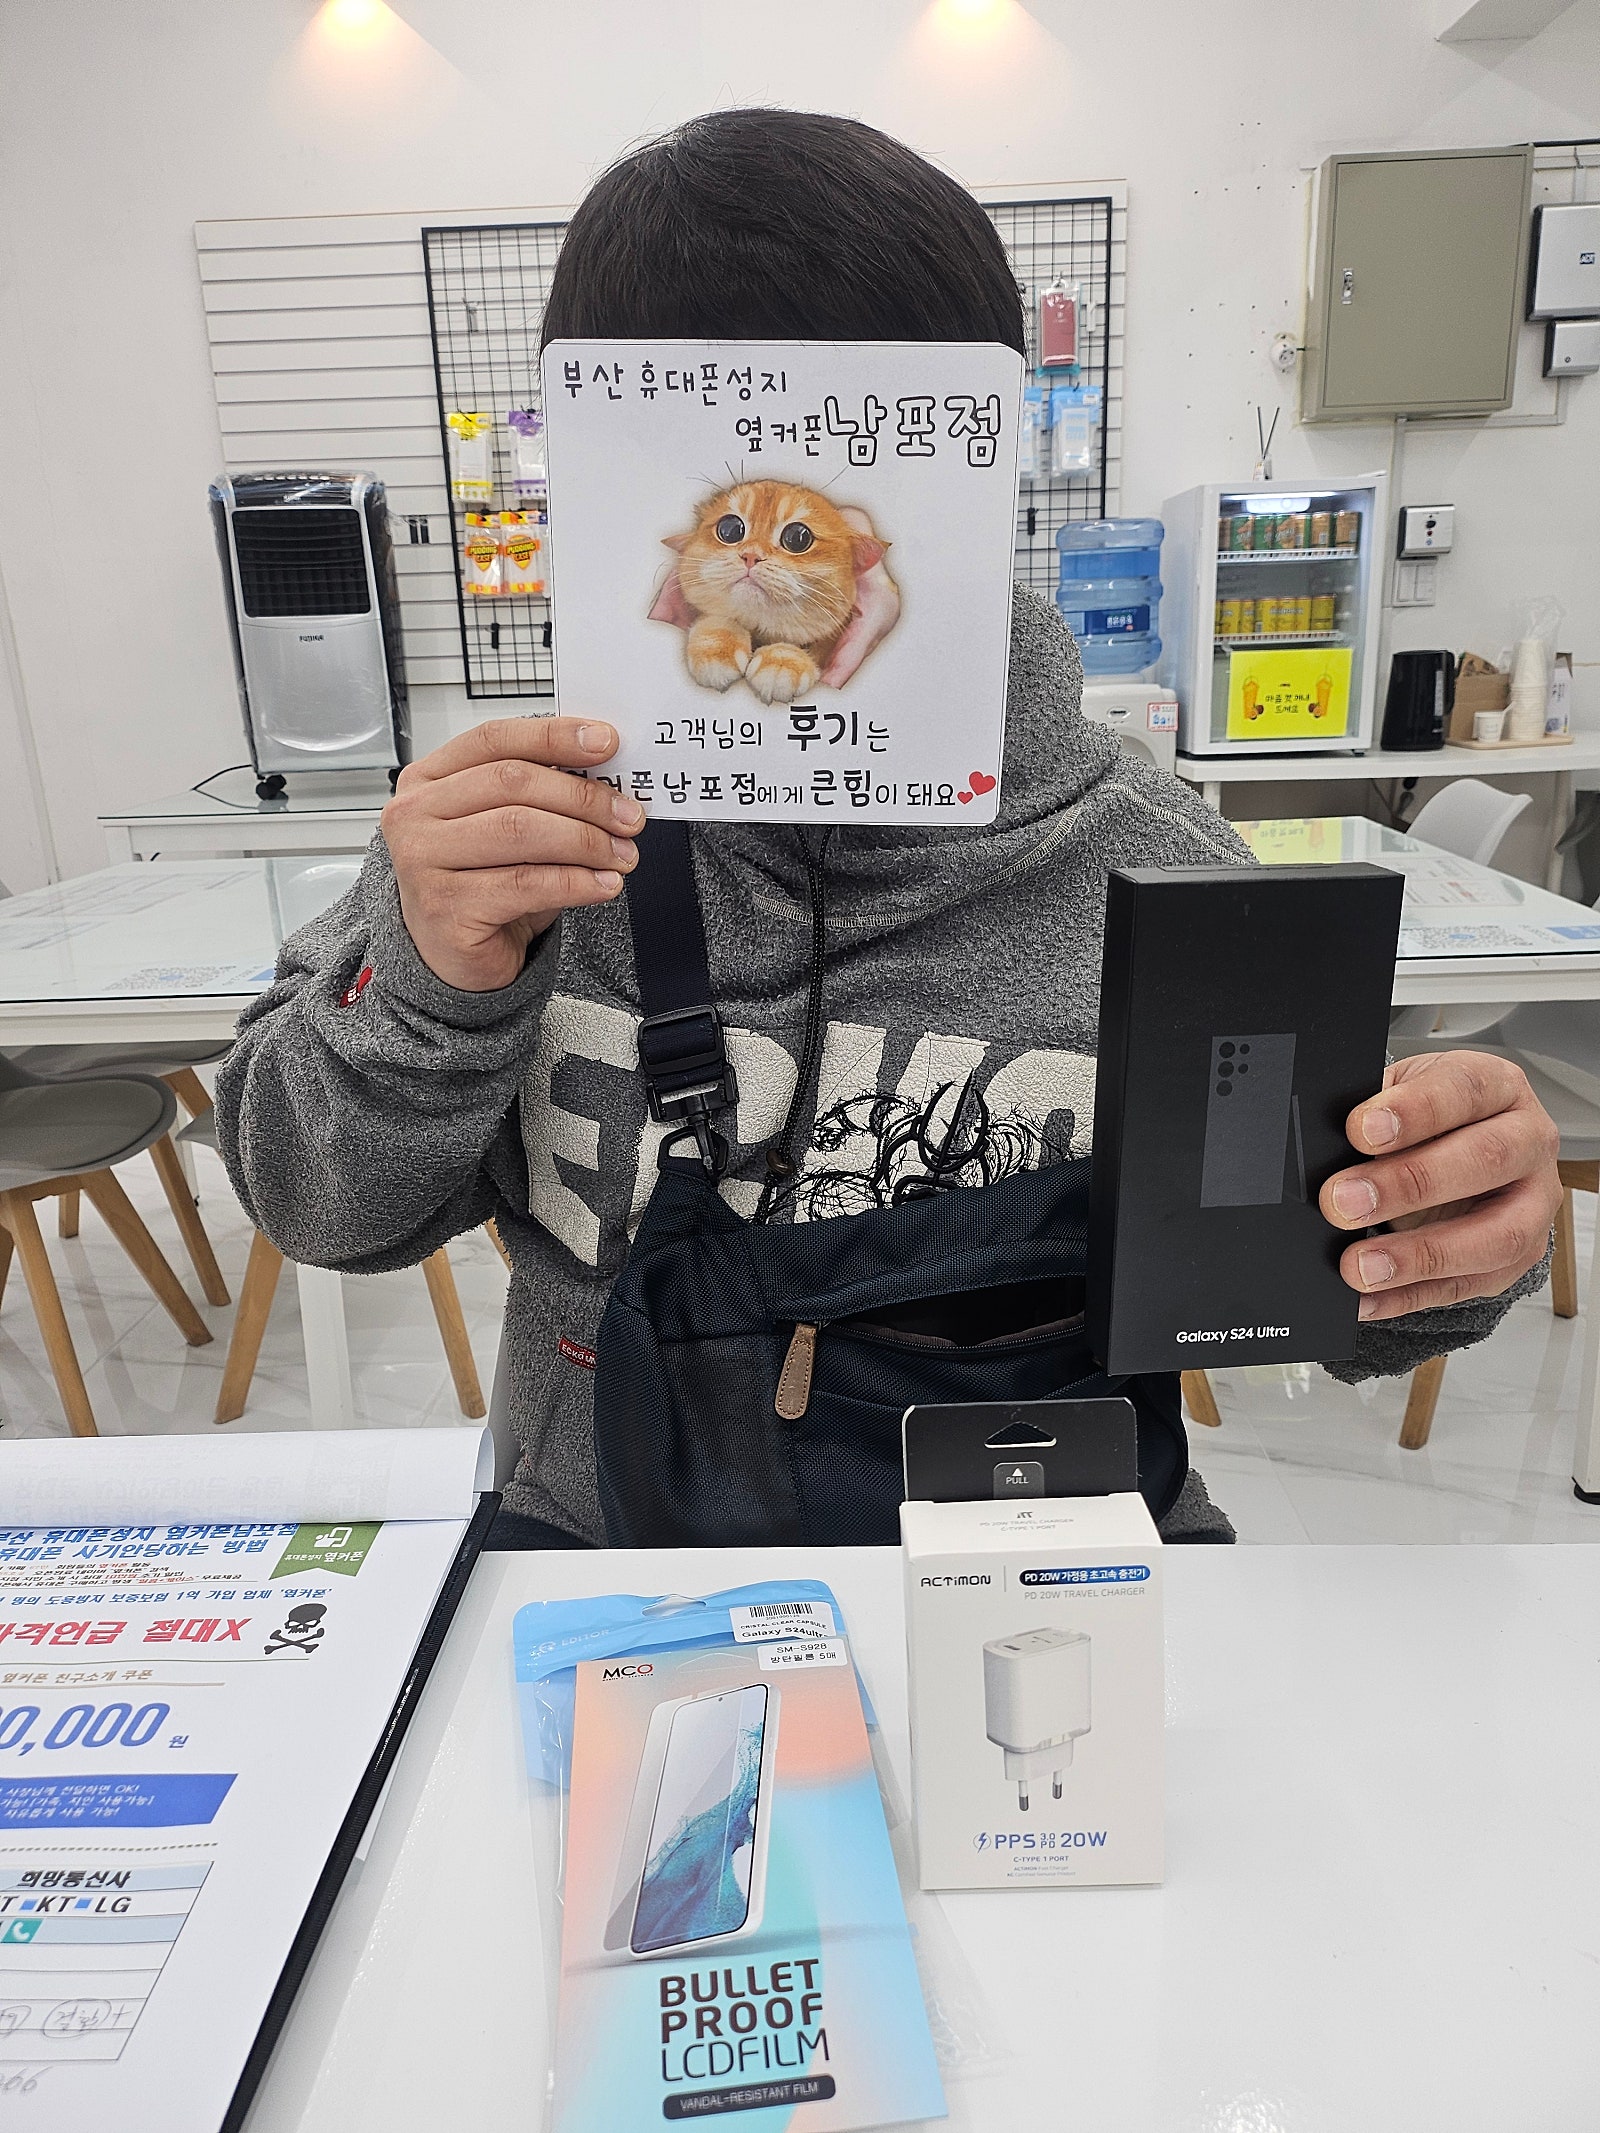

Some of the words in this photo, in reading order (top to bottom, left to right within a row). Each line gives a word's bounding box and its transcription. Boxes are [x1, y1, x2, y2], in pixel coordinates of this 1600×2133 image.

[564, 360, 624, 400] 부산
[640, 360, 787, 406] 휴대폰성지
[654, 717, 763, 750] 고객님의
[787, 705, 891, 753] 후기는
[566, 769, 804, 804] 커폰남포점에게
[906, 782, 957, 807] 돼요
[1176, 1328, 1229, 1344] Galaxy
[1230, 1326, 1254, 1341] S24
[1256, 1325, 1290, 1340] Ultra
[1005, 1476, 1029, 1485] PULL
[42, 1527, 156, 1544] 휴대폰성지
[165, 1523, 299, 1541] 옆커폰남포점
[0, 1546, 65, 1561] 휴대폰
[72, 1542, 209, 1560] 사기안당하는
[222, 1539, 269, 1554] 방법
[324, 1550, 364, 1563] 옆커폰
[1025, 1573, 1038, 1582] PD
[1040, 1572, 1061, 1582] 20W
[1062, 1571, 1089, 1582] 가정용
[1089, 1569, 1117, 1580] 초고속
[1119, 1568, 1147, 1579] 충전기
[11, 1596, 42, 1605] 명의
[44, 1593, 106, 1605] 도용방지
[112, 1592, 170, 1604] 보증보험
[176, 1590, 201, 1601] 1억
[205, 1590, 236, 1600] 가입
[242, 1589, 273, 1600] 업체
[1024, 1591, 1037, 1600] PD
[1040, 1590, 1061, 1599] 20W
[1064, 1589, 1099, 1598] TRAVEL
[1100, 1587, 1145, 1597] CHARGER
[742, 1629, 781, 1638] Galaxy
[796, 1619, 827, 1630] CAPSULE
[776, 1643, 827, 1653] SM-S928
[771, 1653, 815, 1664] 방탄필름
[1, 1672, 49, 1684] 옆커폰
[55, 1670, 118, 1684] 친구소개
[121, 1669, 153, 1681] 쿠폰
[603, 1664, 653, 1679] MCO
[0, 1702, 170, 1756] 0,000
[169, 1735, 190, 1749] 원
[114, 1784, 140, 1794] OK!
[994, 1834, 1036, 1849] PPS
[1040, 1840, 1056, 1849] PD
[1060, 1831, 1108, 1848] 20W
[17, 1870, 132, 1889] 희망통신사
[0, 1895, 20, 1912] T
[36, 1895, 77, 1912] KT
[94, 1896, 132, 1913] LG
[659, 1958, 819, 2008] BULLET
[660, 1992, 823, 2044] PROOF
[661, 2027, 831, 2082] LCDFILM
[679, 2084, 790, 2111] VANDAL-RESISTANT
[793, 2080, 819, 2096] FILM
